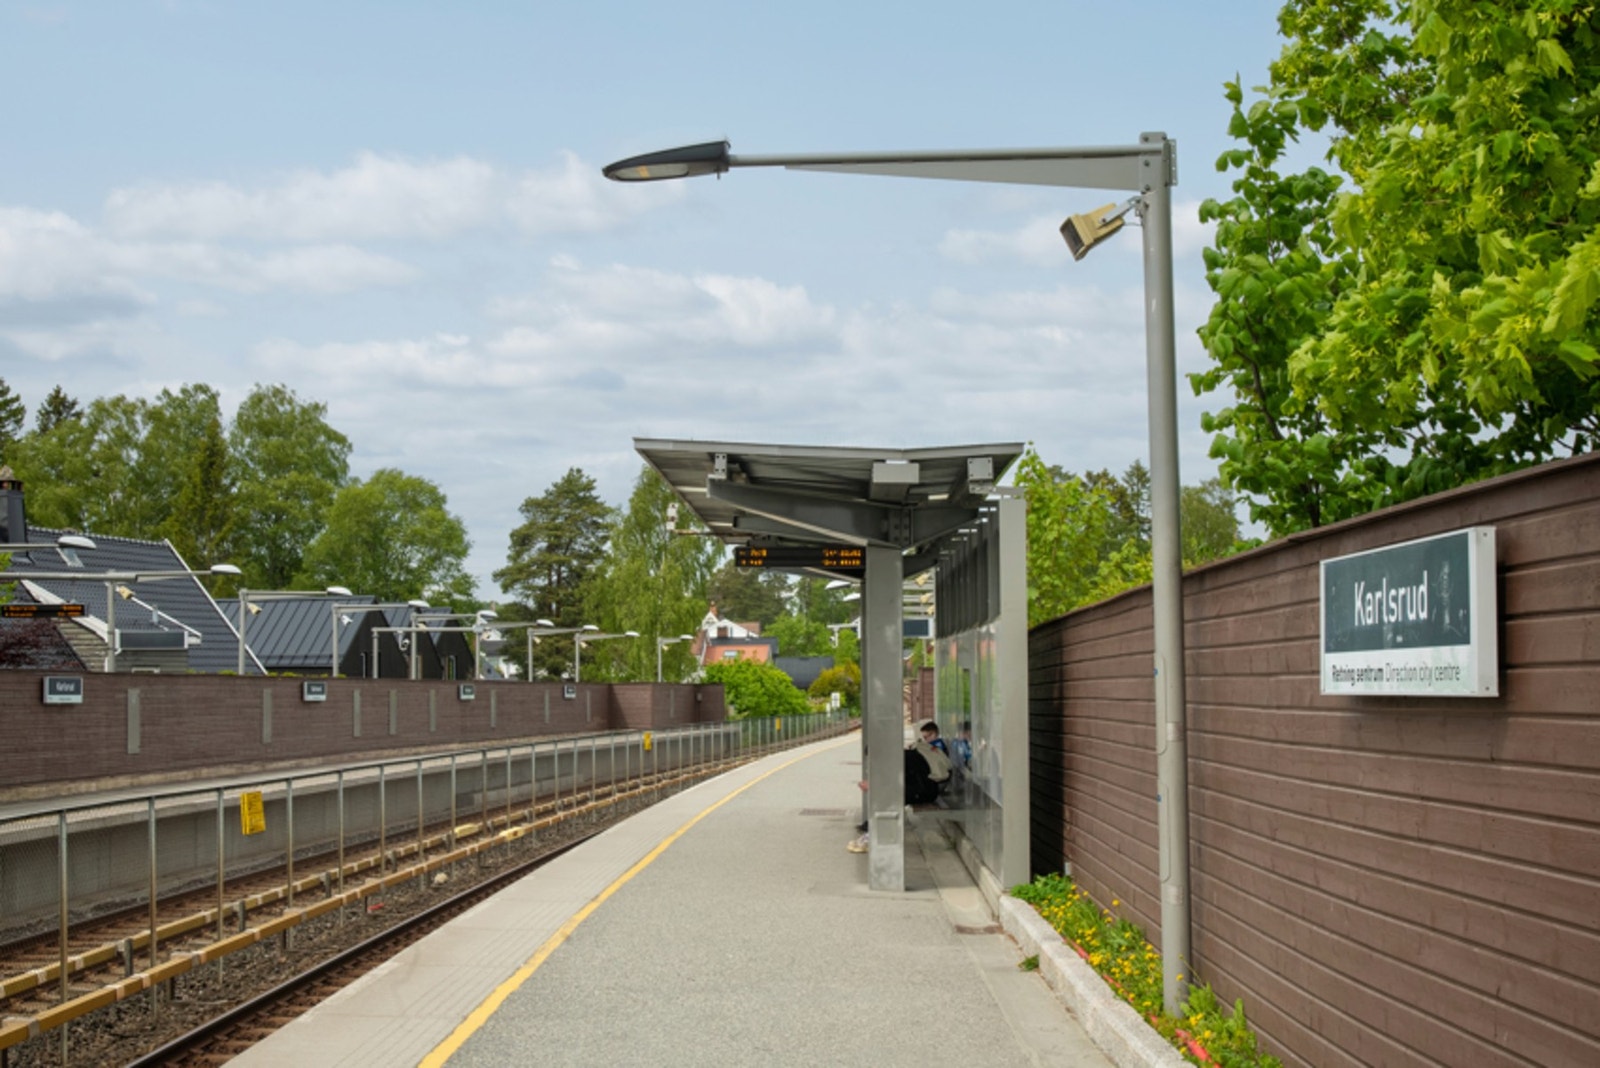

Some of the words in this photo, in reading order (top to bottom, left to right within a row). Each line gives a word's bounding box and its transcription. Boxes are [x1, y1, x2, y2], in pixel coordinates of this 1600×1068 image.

[1354, 570, 1427, 626] Karlsrud
[1332, 664, 1355, 686] Retning
[1356, 665, 1384, 682] sentrum
[1385, 662, 1417, 682] Direction
[1419, 661, 1432, 686] city
[1434, 662, 1461, 681] centre
